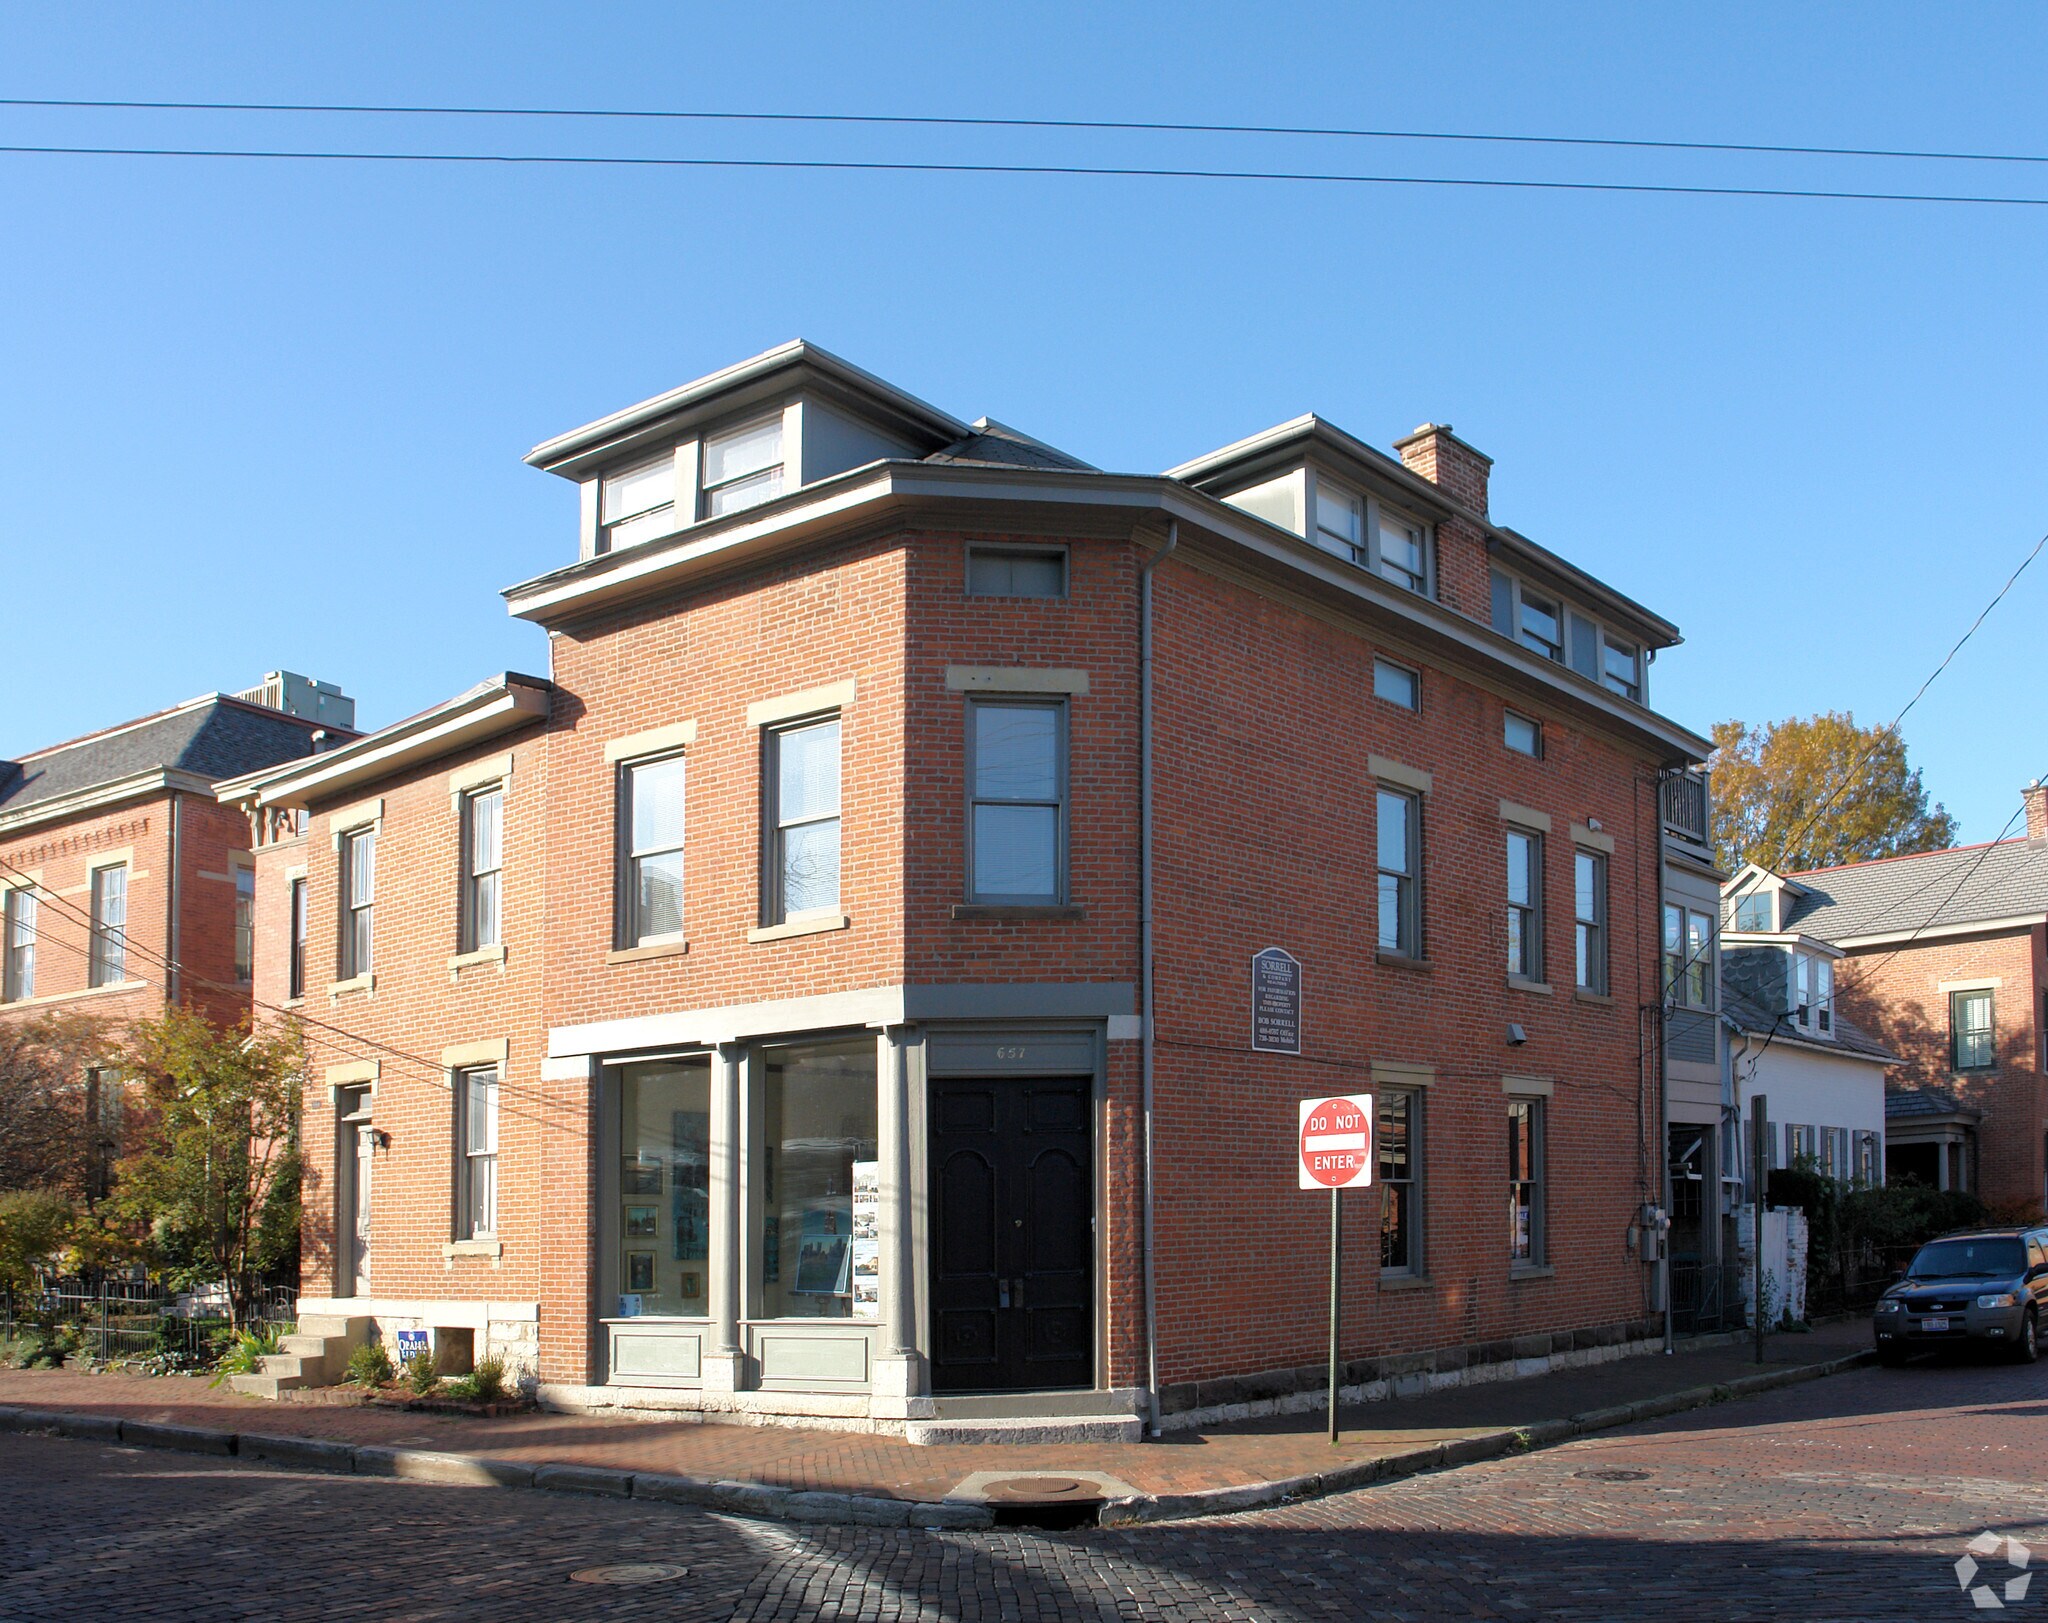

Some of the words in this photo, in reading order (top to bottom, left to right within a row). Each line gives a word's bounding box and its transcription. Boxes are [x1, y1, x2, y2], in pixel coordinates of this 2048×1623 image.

[1262, 960, 1292, 972] SORRELL
[1270, 1018, 1295, 1027] SORRELL
[997, 1047, 1025, 1059] 657
[1311, 1116, 1327, 1131] DO
[1336, 1114, 1360, 1129] NOT
[1314, 1155, 1354, 1170] ENTER
